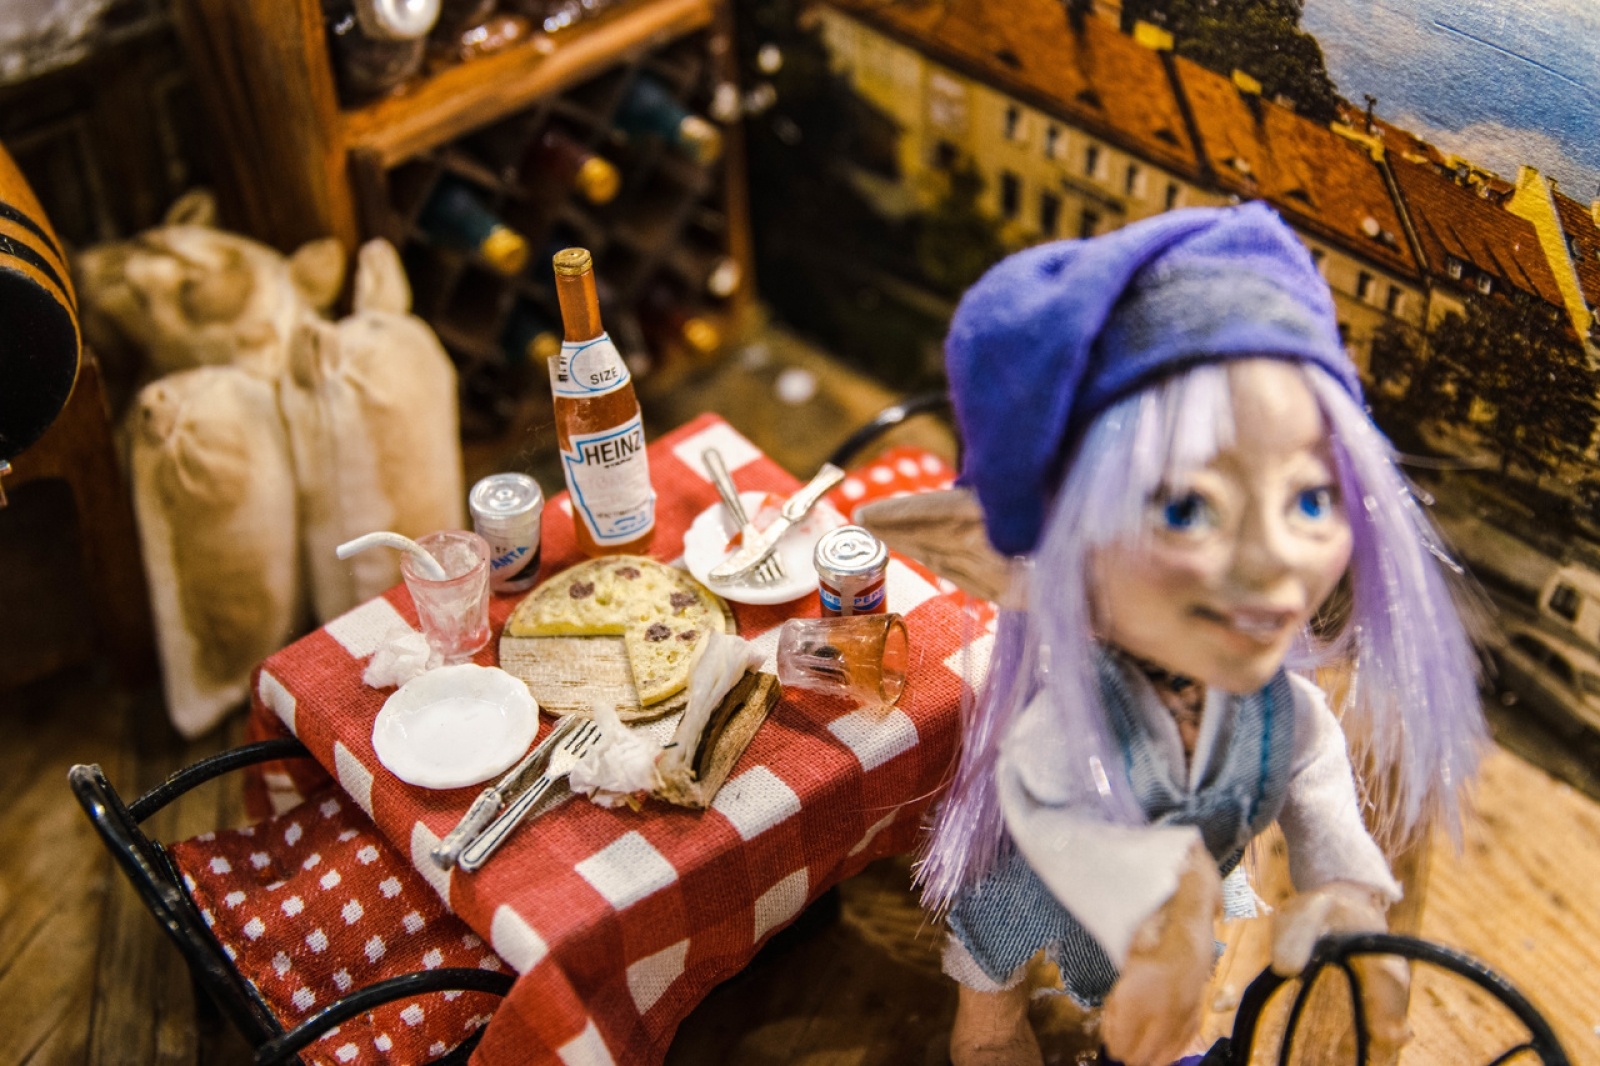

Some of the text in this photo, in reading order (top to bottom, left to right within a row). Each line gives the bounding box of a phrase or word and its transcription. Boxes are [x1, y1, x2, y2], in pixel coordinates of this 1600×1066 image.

[590, 367, 618, 385] SIZE
[584, 430, 641, 466] HEINZ
[490, 546, 529, 571] ANTA
